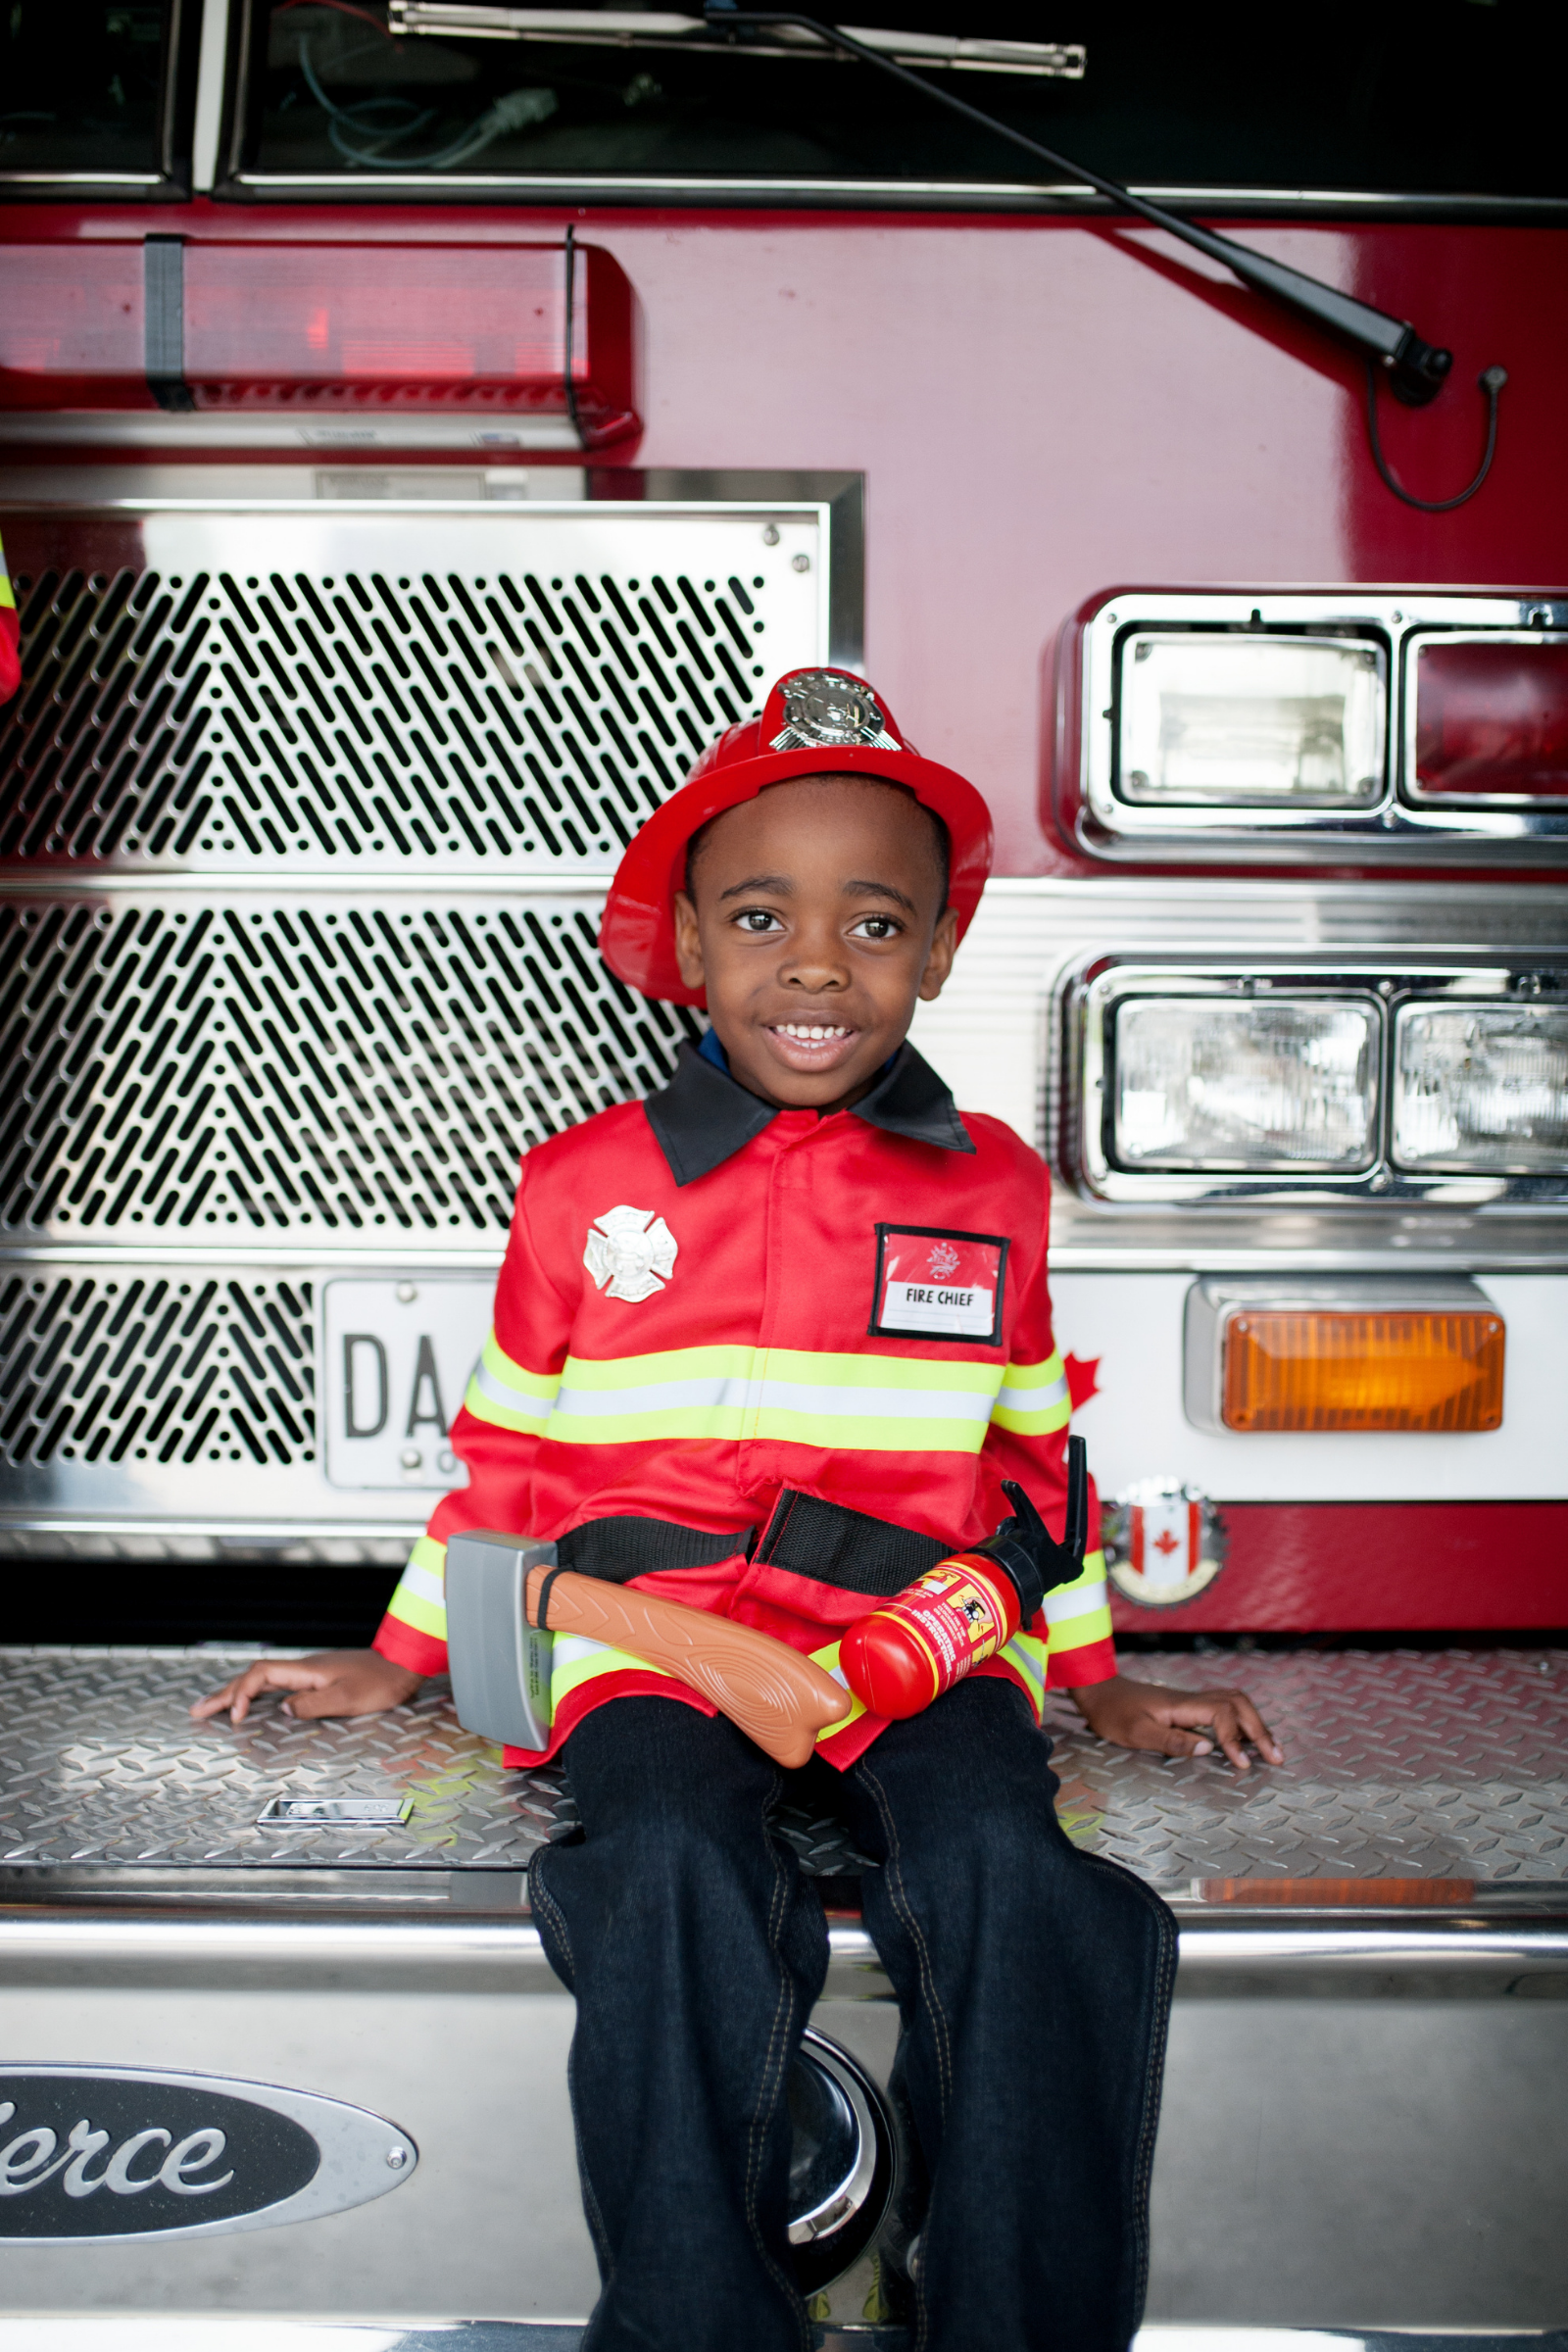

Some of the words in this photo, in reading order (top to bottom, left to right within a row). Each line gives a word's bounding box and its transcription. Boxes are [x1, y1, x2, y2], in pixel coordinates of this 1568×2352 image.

[906, 1289, 933, 1303] FIRE
[938, 1291, 974, 1306] CHIEF
[344, 1335, 449, 1437] DA
[923, 1610, 956, 1662] OPERATING
[933, 1607, 941, 1616] ON
[911, 1609, 953, 1674] INSTRUCTIONS
[0, 2101, 235, 2198] erce
